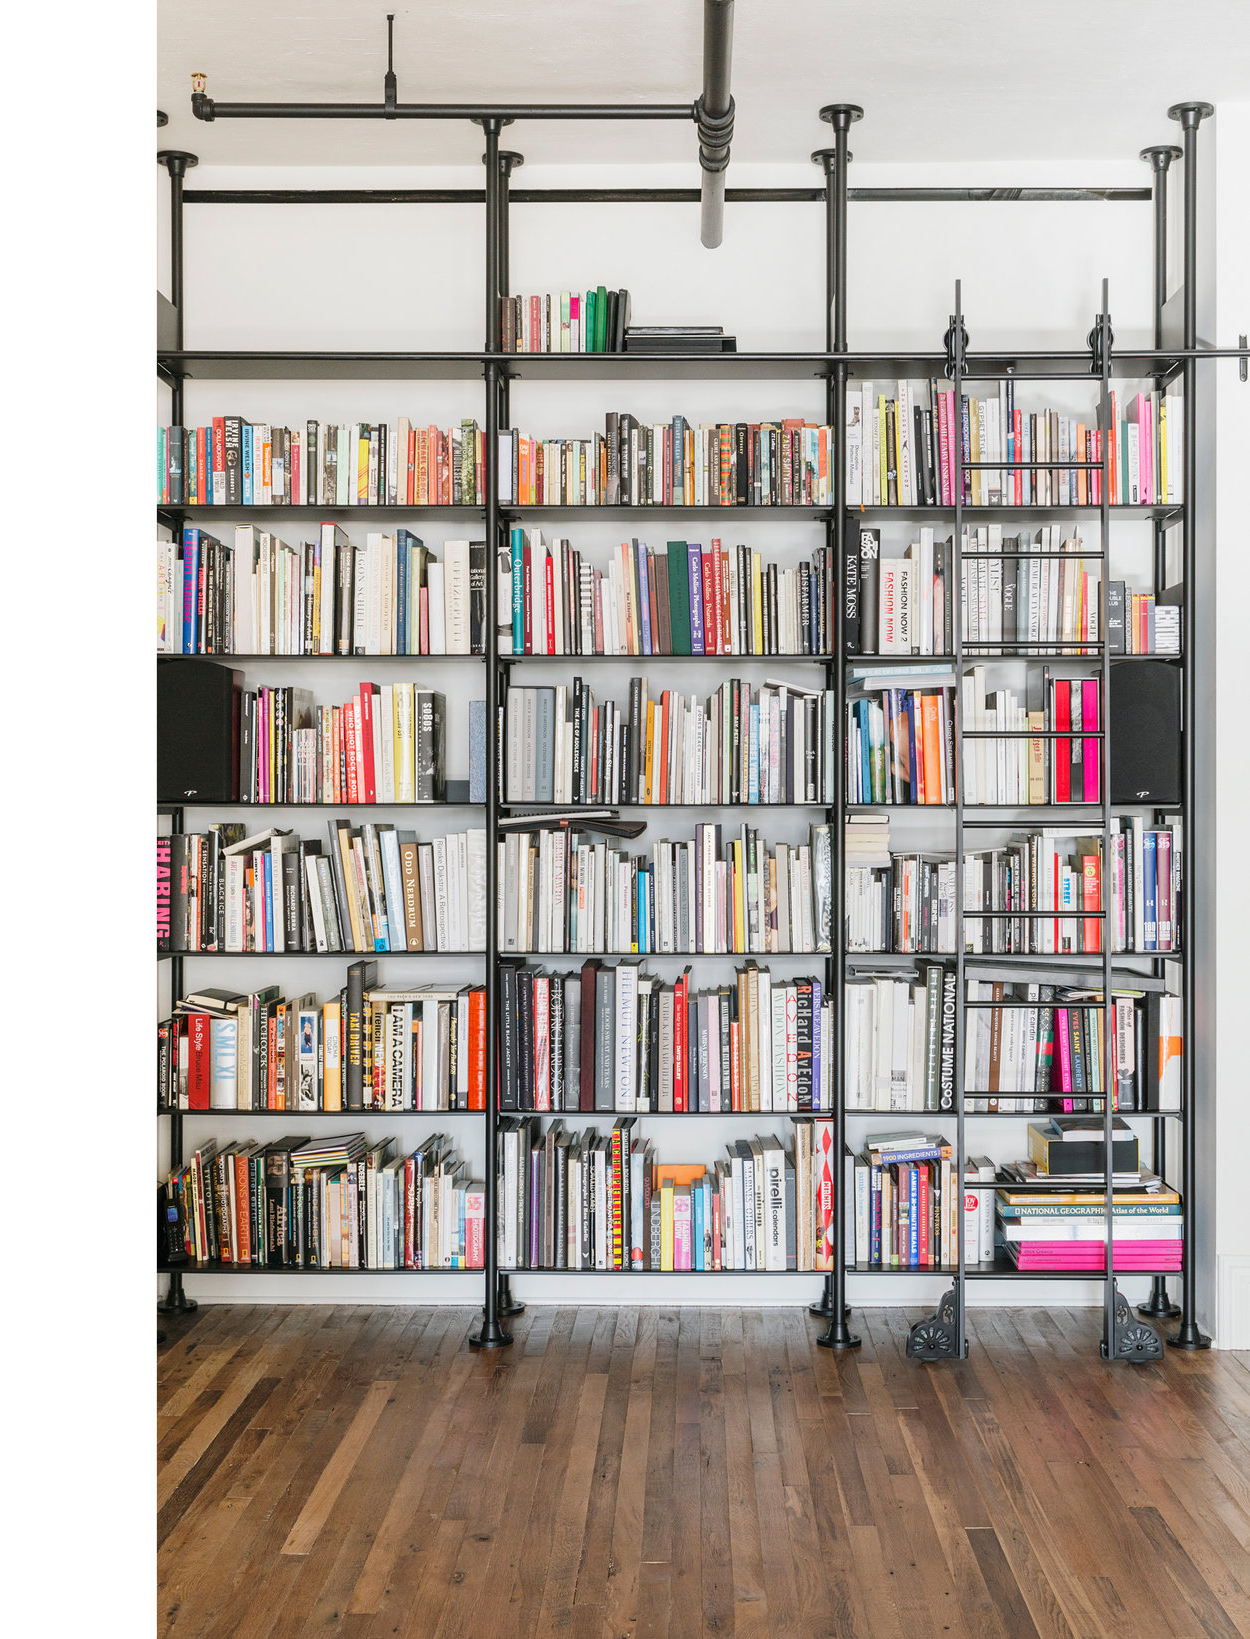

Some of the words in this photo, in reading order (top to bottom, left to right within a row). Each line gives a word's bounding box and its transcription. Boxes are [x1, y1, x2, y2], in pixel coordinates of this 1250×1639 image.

[184, 540, 198, 574] Henri
[357, 552, 365, 582] EGON
[846, 554, 857, 586] KATE
[513, 559, 522, 614] Outerbridge
[801, 570, 810, 626] DISFARMER
[846, 587, 857, 619] MOSS
[885, 572, 894, 610] FASHION
[885, 619, 893, 642] NOW
[157, 847, 171, 938] HARING
[1063, 878, 1071, 904] STREET
[439, 902, 447, 949] Retrospective
[621, 971, 631, 1029] HELMUT
[942, 975, 956, 1043] NATIONAL
[195, 1018, 203, 1031] Life
[260, 1008, 268, 1067] HITCHCOCK
[350, 1012, 360, 1031] TAXI
[392, 1015, 403, 1036] AM
[195, 1033, 203, 1051] Style
[350, 1034, 360, 1065] DRIVER
[392, 1039, 403, 1048] A
[195, 1051, 203, 1072] Bruce
[392, 1049, 403, 1107] CAMERA
[621, 1035, 631, 1098] NEWTON
[1074, 1054, 1082, 1088] LAURENT
[897, 1150, 938, 1160] INGREDIENTS
[238, 1160, 246, 1197] VISIONS
[769, 1169, 782, 1209] pirelli
[822, 1181, 831, 1210] CIRCUS
[1021, 1207, 1059, 1215] NATIONAL
[239, 1211, 247, 1244] EARTH
[276, 1205, 287, 1246] Africa
